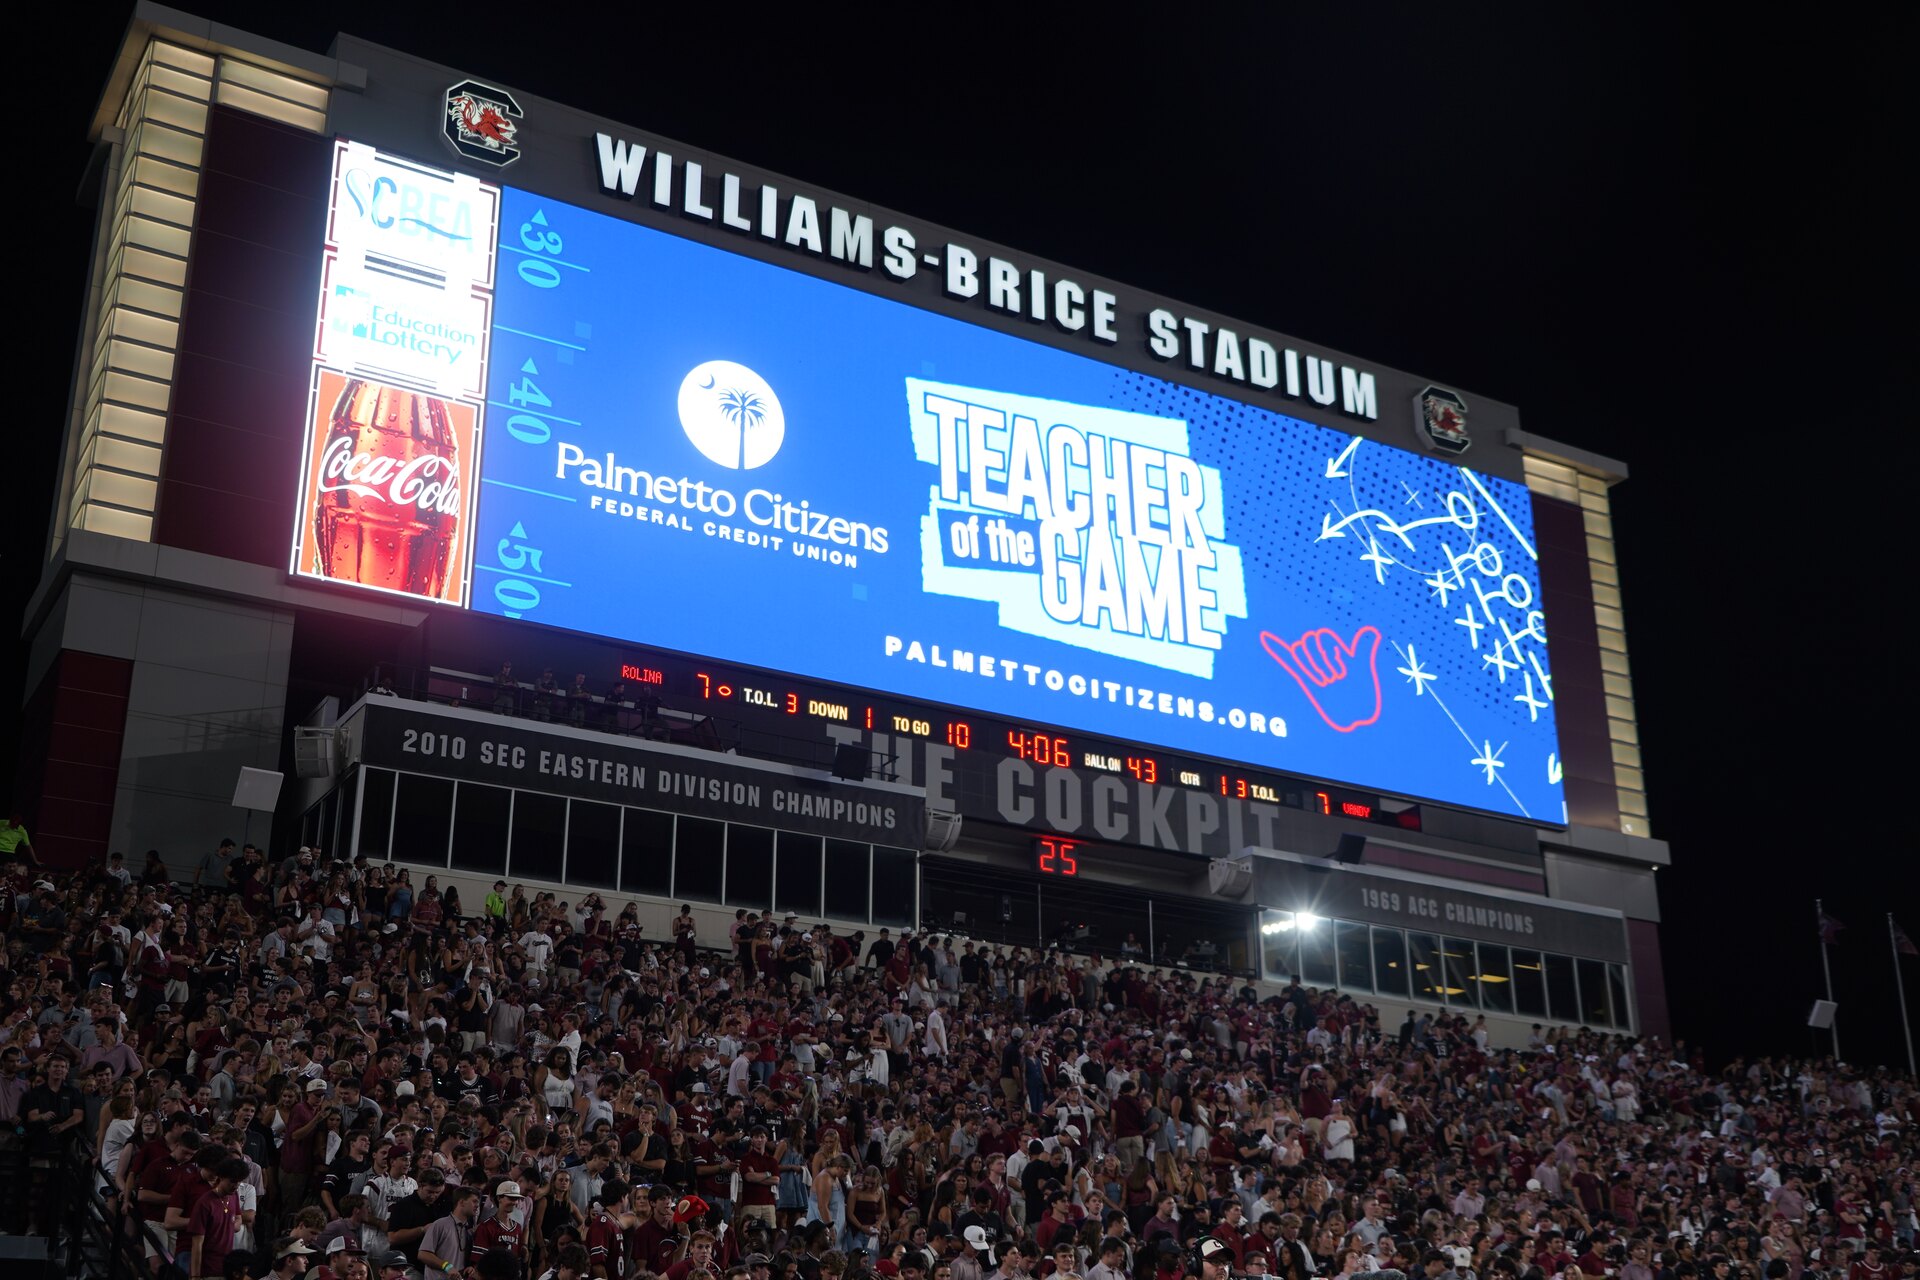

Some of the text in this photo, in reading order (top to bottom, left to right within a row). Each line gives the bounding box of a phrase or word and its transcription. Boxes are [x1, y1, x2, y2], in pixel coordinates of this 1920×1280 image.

[372, 304, 476, 346] Education
[596, 132, 1377, 421] WILLIAMS-BRICE STADIUM
[370, 321, 462, 364] Lottery
[318, 436, 460, 518] Coca-Cola
[555, 441, 889, 554] Palmetto Citizens
[924, 393, 1212, 555] TEACHER
[590, 495, 858, 568] FEDERAL CREDIT UNION
[950, 515, 1036, 568] of the
[1038, 514, 1222, 650] GAME
[884, 635, 1288, 738] PALMETTOCITIZENS.ORG
[402, 728, 896, 830] 2010 SEC EASTERN DIVISION CHAMPIONS
[622, 665, 662, 685] ROLINA
[697, 673, 709, 699] 7
[743, 687, 779, 708] T.O.L.
[786, 693, 798, 713] 3
[809, 700, 848, 721] DOWN
[866, 707, 873, 730] 1
[893, 716, 909, 732] TO
[912, 720, 931, 736] GO
[947, 723, 969, 748] 10
[1008, 730, 1071, 768] 4:06
[1084, 752, 1107, 770] BALL
[1107, 757, 1121, 772] ON
[1127, 757, 1157, 784] 43
[1180, 771, 1200, 787] QTR
[1220, 775, 1228, 796] 1
[1236, 779, 1247, 799] 3
[1250, 784, 1280, 802] T.O.L.
[1317, 793, 1330, 815] 7
[997, 756, 1279, 860] COCKPIT
[1039, 841, 1077, 876] 25
[1361, 887, 1535, 934] 1969 ACC CHAMPIONS
